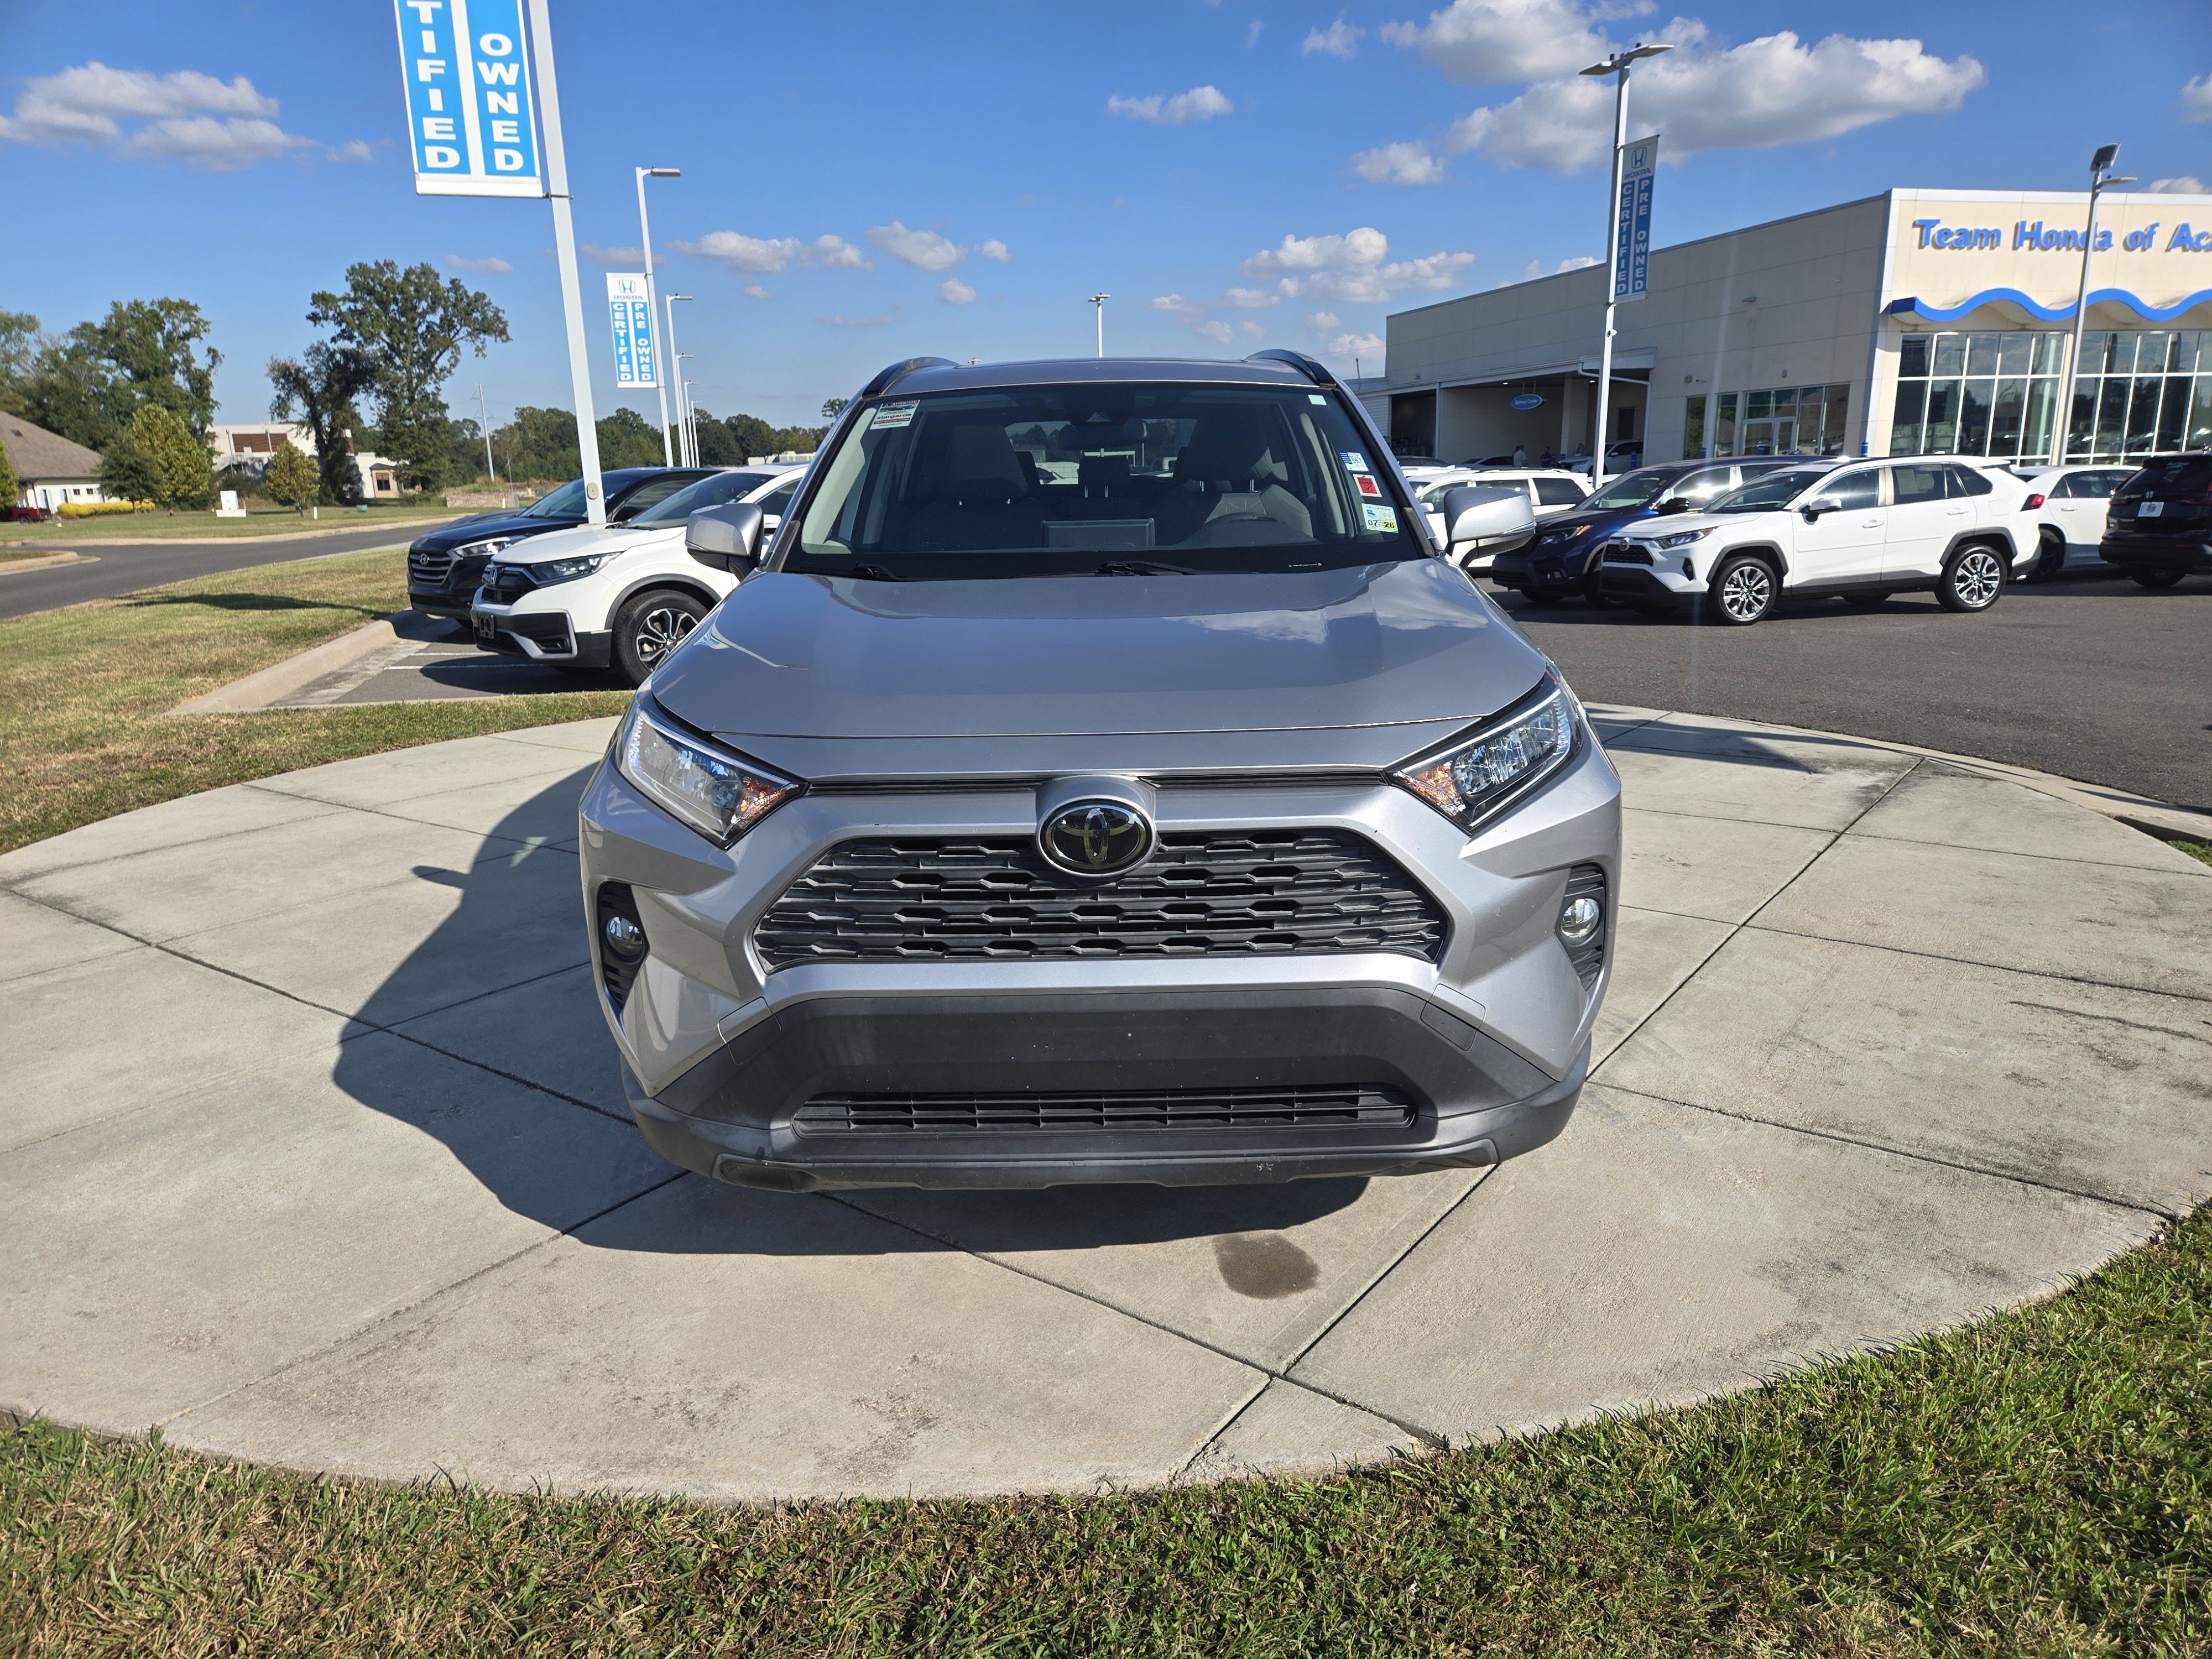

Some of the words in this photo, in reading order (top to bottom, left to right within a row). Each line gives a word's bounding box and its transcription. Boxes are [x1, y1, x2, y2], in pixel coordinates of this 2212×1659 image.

[407, 0, 460, 168] TIFIED
[477, 33, 524, 171] OWNED
[1624, 168, 1651, 180] HONDA
[1639, 179, 1650, 216] PRE
[1616, 184, 1632, 294] CERTIFIED
[1915, 218, 2002, 249] Team
[2016, 220, 2114, 249] Honda
[2126, 221, 2160, 249] of
[2168, 222, 2212, 250] Ac
[1635, 230, 1647, 291] OWNED
[634, 302, 646, 329] PRE
[613, 302, 632, 382] CERTIFIED
[637, 338, 651, 382] OWNED
